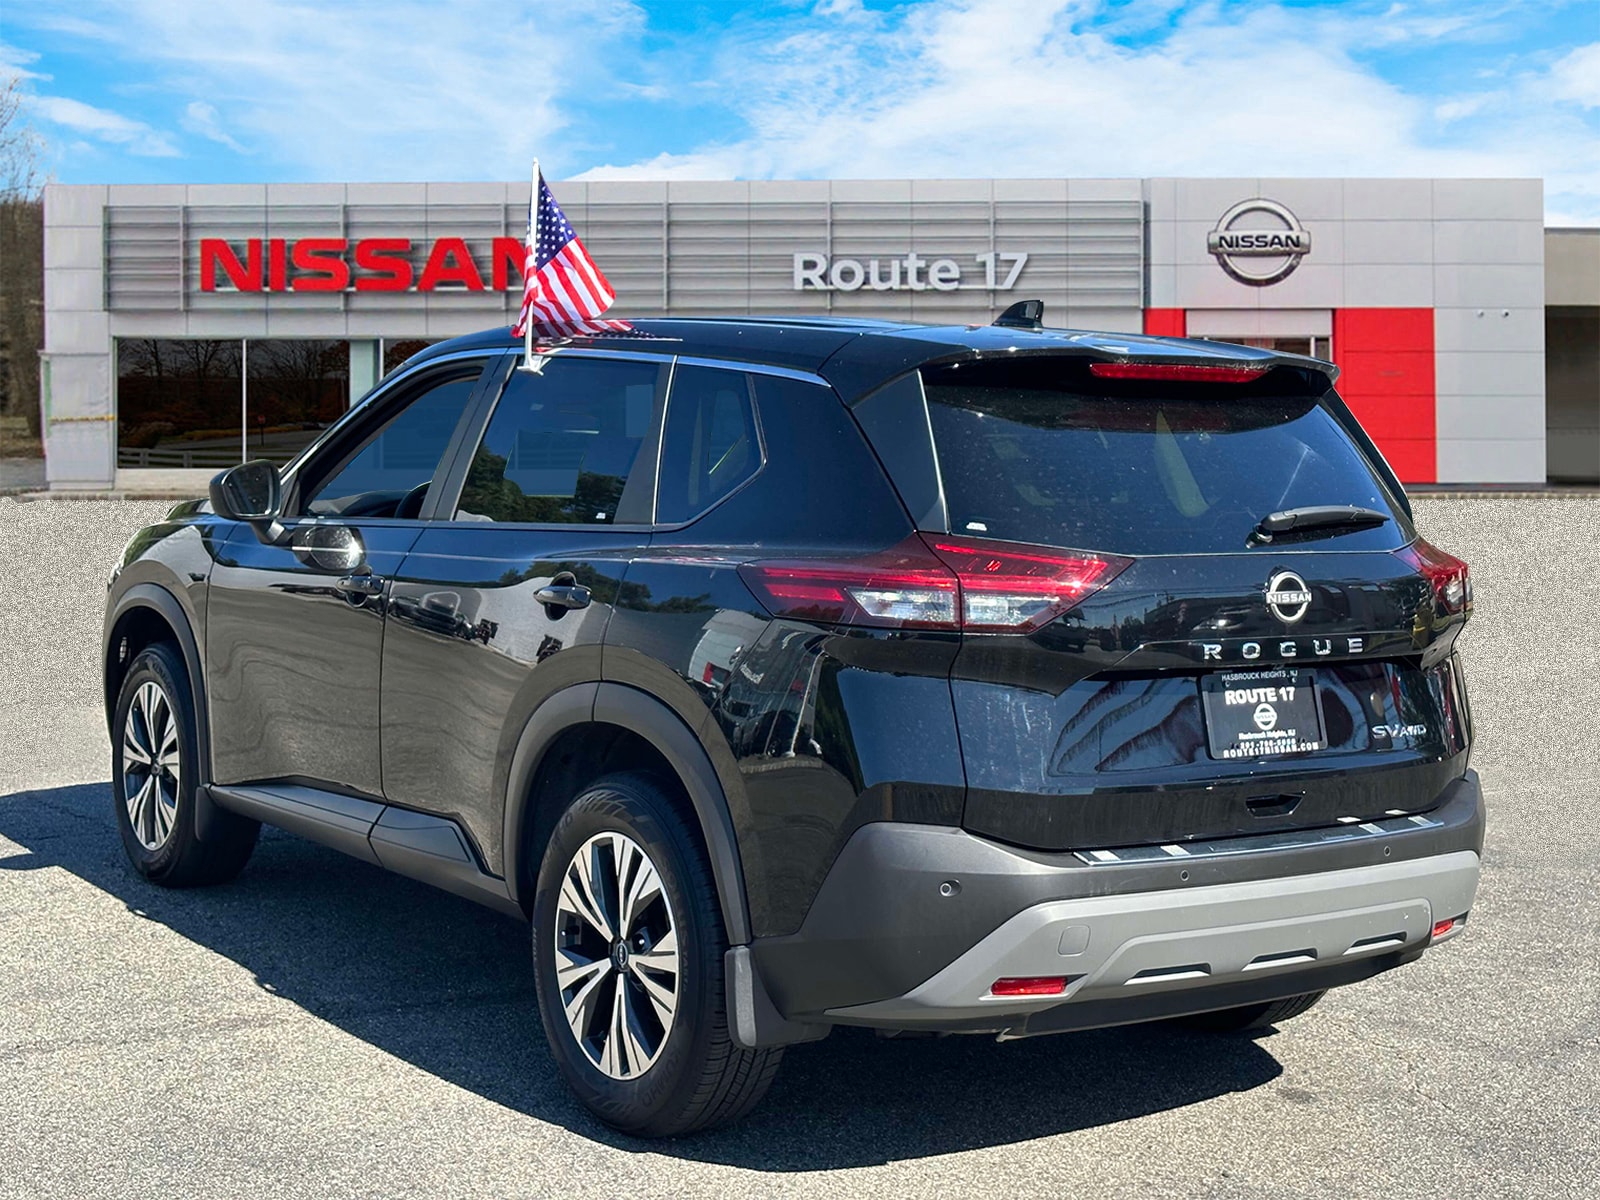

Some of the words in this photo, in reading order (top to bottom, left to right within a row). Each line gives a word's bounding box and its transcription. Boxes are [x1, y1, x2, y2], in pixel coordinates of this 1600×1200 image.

[1218, 234, 1301, 250] NISSAN
[793, 252, 961, 291] Route
[976, 252, 1028, 291] 17
[1267, 592, 1312, 604] NISSAN
[1203, 638, 1364, 660] ROGUE
[1221, 671, 1260, 681] HASBROUCK
[1290, 669, 1298, 677] NJ
[1224, 687, 1278, 705] ROUTE
[1279, 686, 1296, 701] 17
[1372, 723, 1400, 739] SV
